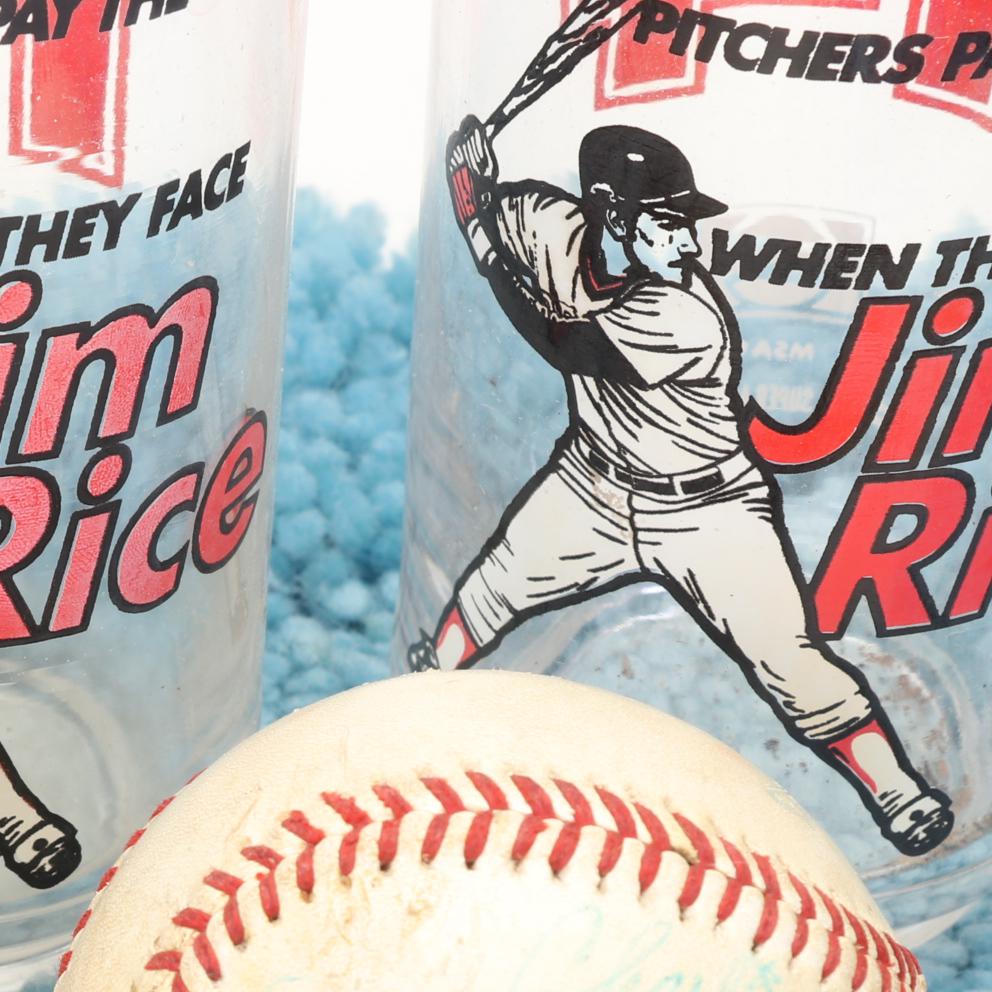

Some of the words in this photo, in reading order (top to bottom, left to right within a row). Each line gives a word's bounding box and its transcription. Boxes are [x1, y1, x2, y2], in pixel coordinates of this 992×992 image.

[633, 8, 934, 85] PITCHERS
[941, 31, 992, 82] P
[146, 141, 251, 238] FACE
[710, 229, 921, 290] WHEN
